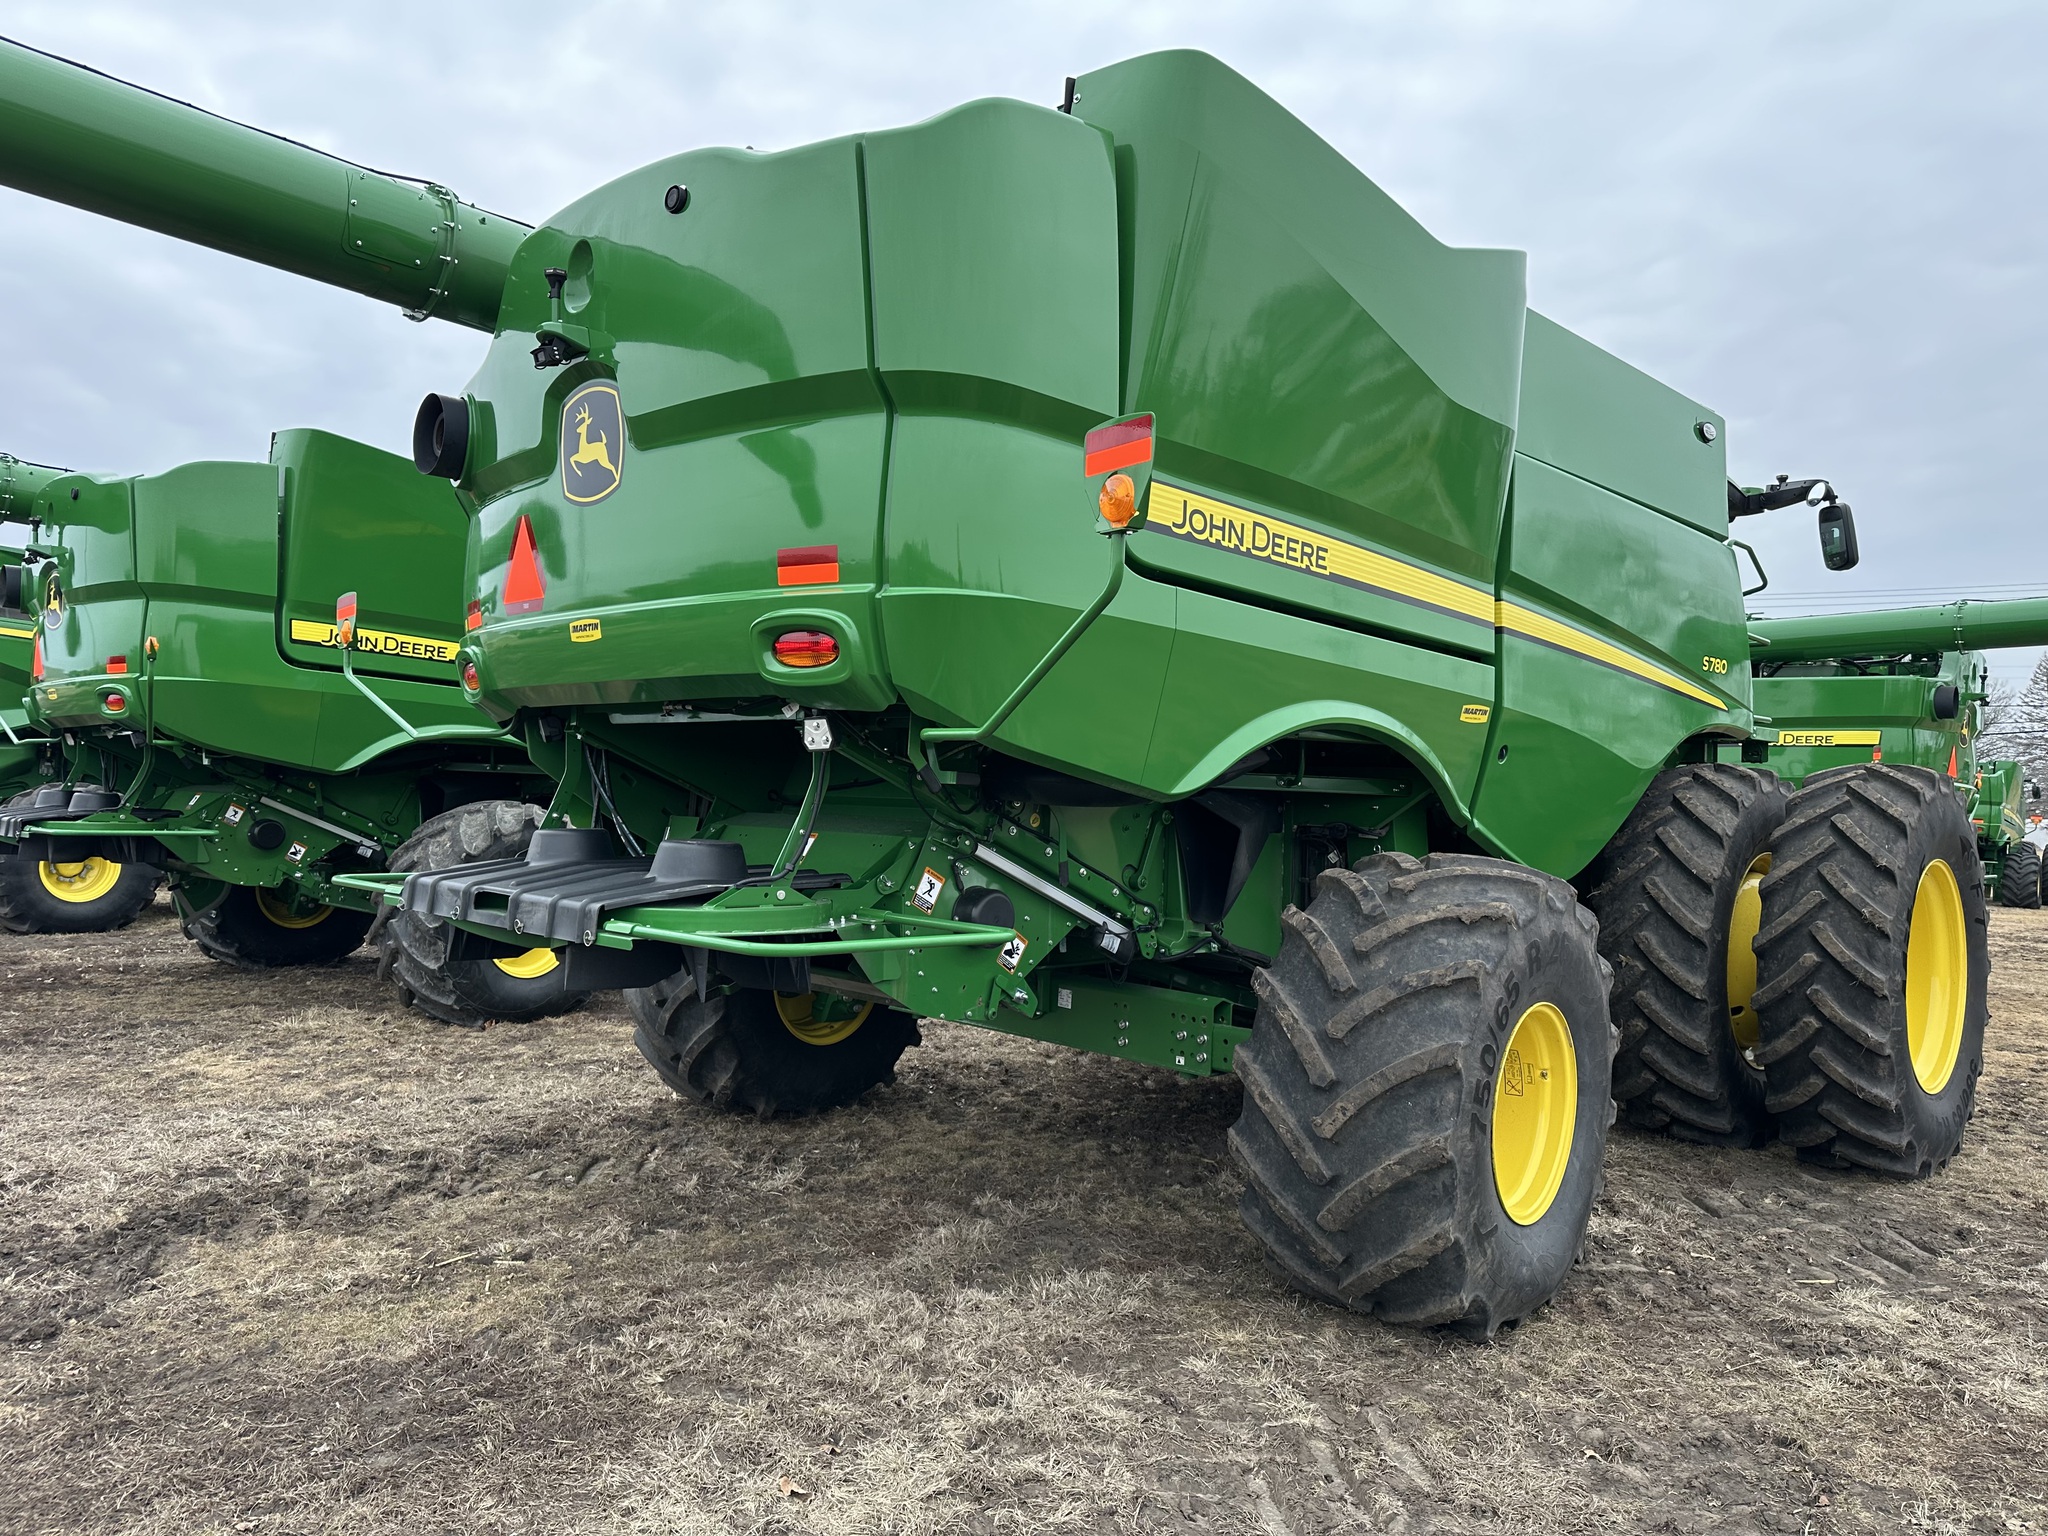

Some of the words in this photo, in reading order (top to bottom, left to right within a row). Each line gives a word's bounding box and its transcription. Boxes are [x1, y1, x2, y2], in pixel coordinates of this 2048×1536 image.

[1171, 499, 1245, 547] JOHN
[1251, 520, 1329, 571] DEERE
[571, 622, 599, 633] MARTIN
[384, 636, 448, 659] DEERE
[1702, 655, 1728, 675] S780
[1462, 707, 1489, 716] MARTIN
[1783, 733, 1834, 745] DEERE
[1470, 970, 1520, 1143] 750/65
